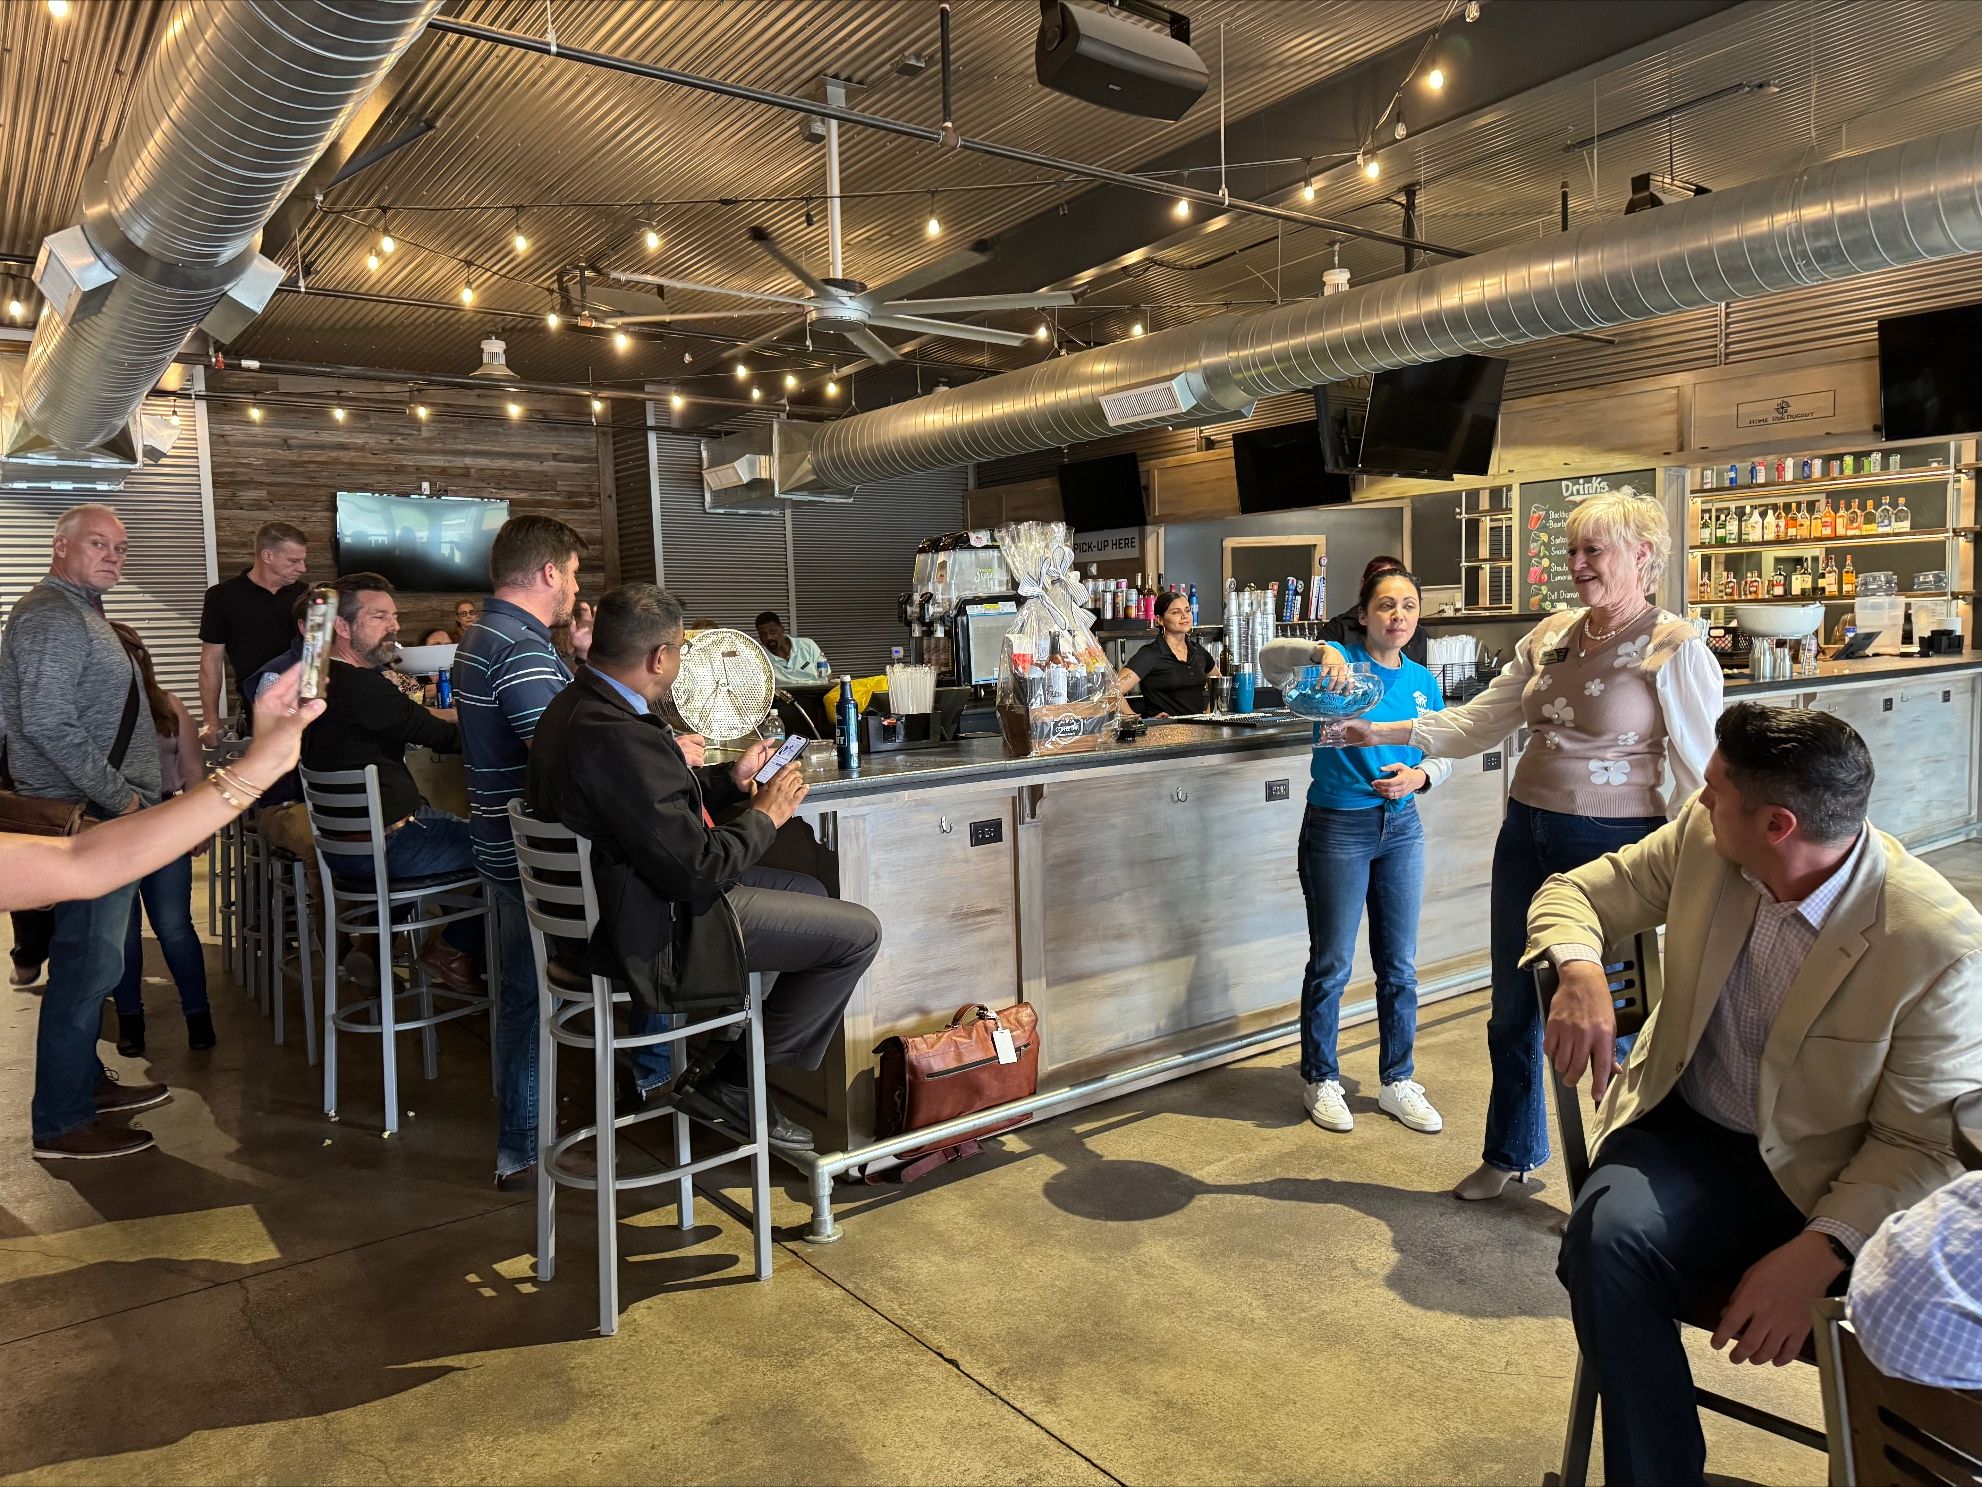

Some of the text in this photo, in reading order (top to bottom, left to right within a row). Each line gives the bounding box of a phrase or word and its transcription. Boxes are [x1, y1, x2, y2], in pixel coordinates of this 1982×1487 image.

[1073, 536, 1137, 553] PICK-UP HERE
[1559, 590, 1580, 599] Diamon
